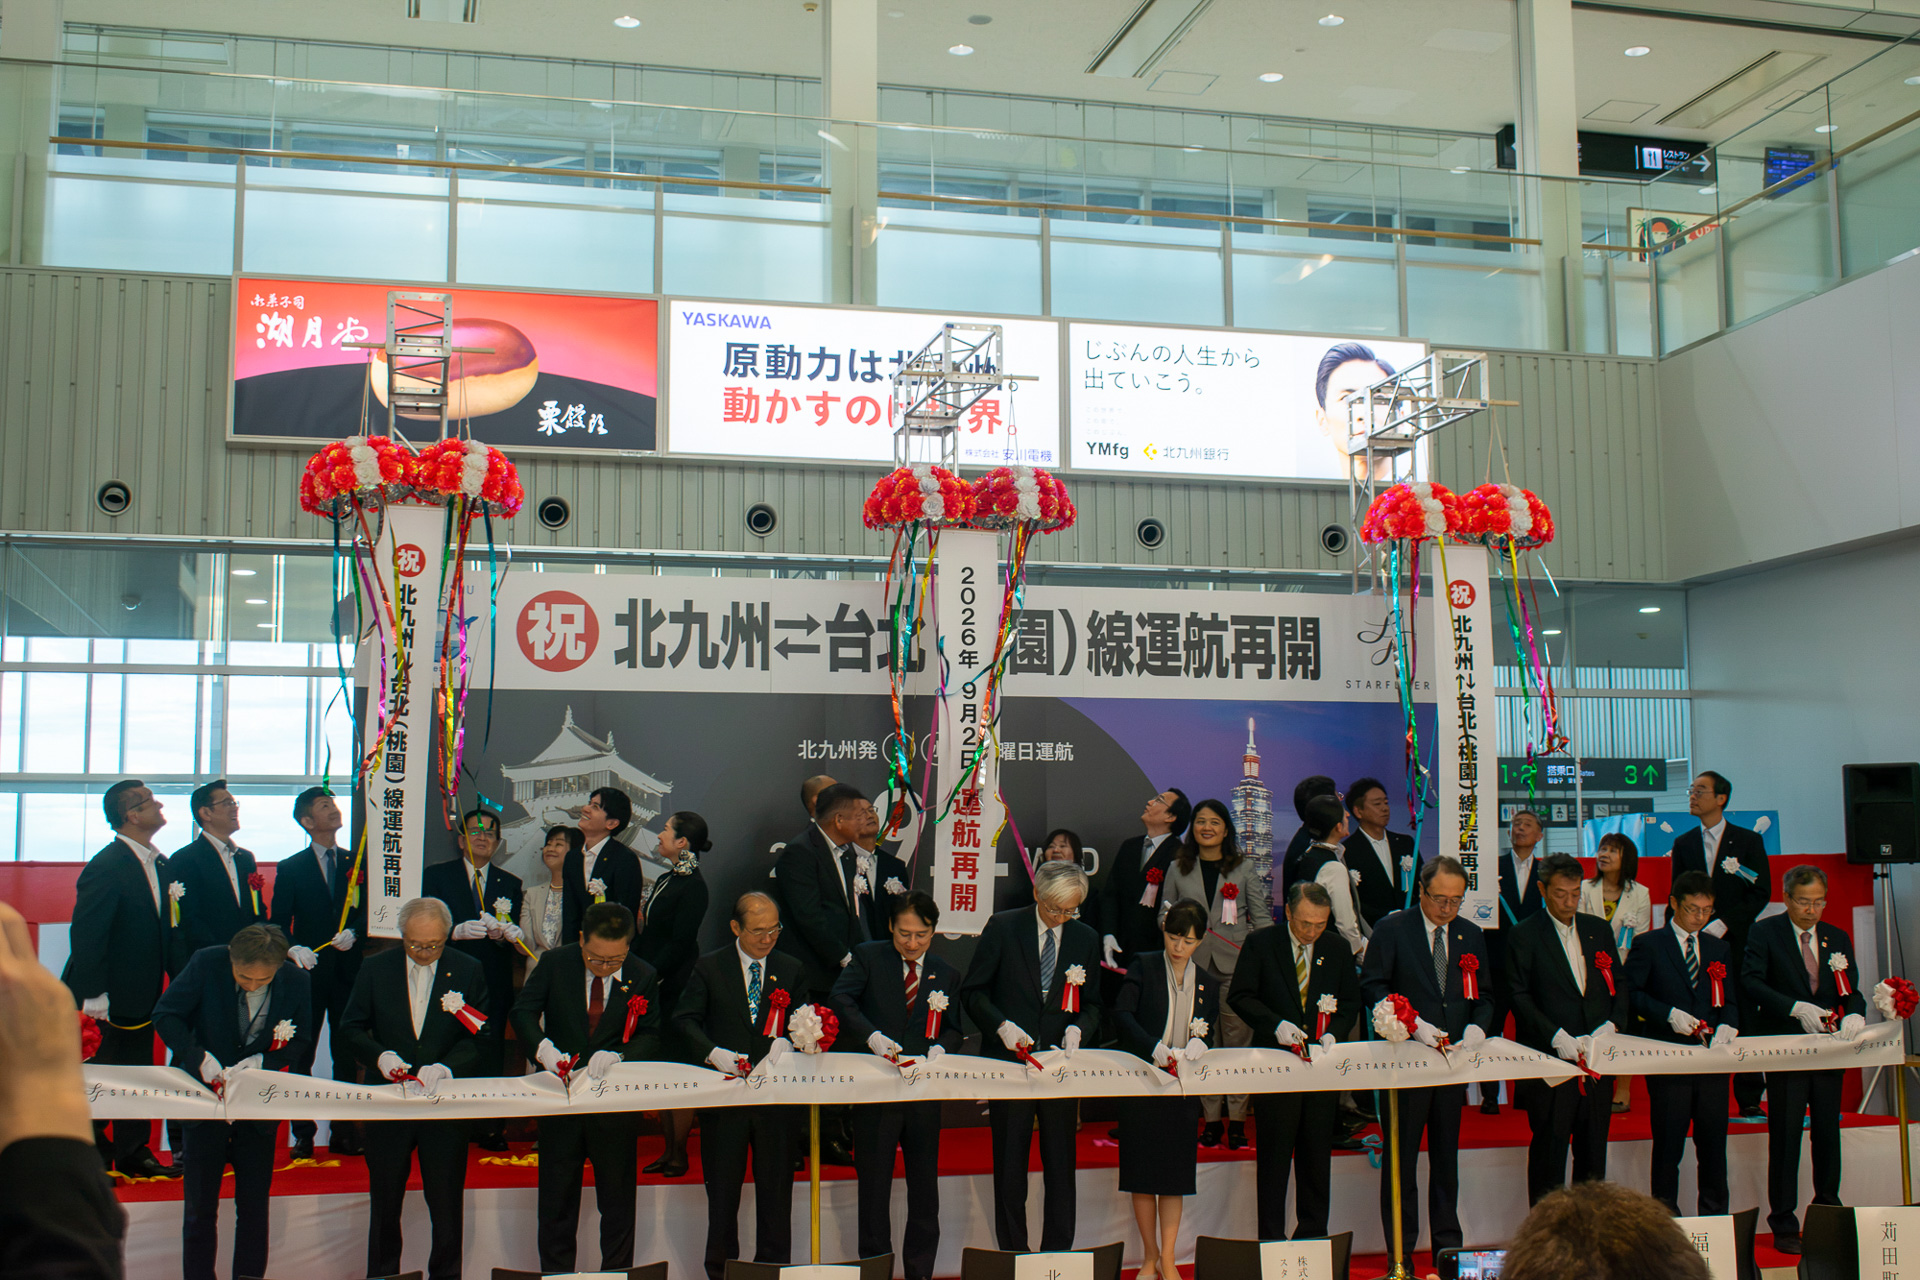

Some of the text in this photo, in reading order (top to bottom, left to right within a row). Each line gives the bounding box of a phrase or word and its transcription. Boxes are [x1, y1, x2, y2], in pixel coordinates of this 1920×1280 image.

[1663, 149, 1690, 160] レストラン
[256, 311, 369, 351] 湖月堂
[682, 311, 772, 330] YASKAWA
[1086, 340, 1260, 368] じぶんの人生から
[1085, 367, 1203, 395] 出ていこう。
[1002, 448, 1053, 462] 安川電機
[1086, 442, 1129, 459] YMfg
[1163, 446, 1229, 461] 北九州銀行
[398, 549, 420, 572] 祝
[1451, 585, 1471, 604] 祝
[958, 567, 979, 669] 2026年
[526, 602, 587, 660] 祝
[1346, 680, 1430, 690] STARFLER
[1546, 765, 1575, 777] 搭乗口
[1624, 765, 1638, 785] 3
[950, 788, 981, 912] 運航再開
[110, 1089, 202, 1097] STARFLYER
[284, 1090, 373, 1100] STARFLYER
[614, 1081, 699, 1092] STARFLYER
[773, 1075, 855, 1083] STARFLYER
[926, 1071, 1005, 1080] STARFLYER
[1073, 1069, 1148, 1077] STARFLYER
[1215, 1065, 1291, 1076] STARFLYER
[1356, 1060, 1429, 1071] STARFLYER
[1623, 1049, 1694, 1057] STARFLYER
[1752, 1048, 1818, 1056] STARFLYER
[1690, 1232, 1710, 1269] 福
[1297, 1256, 1309, 1280] 株式
